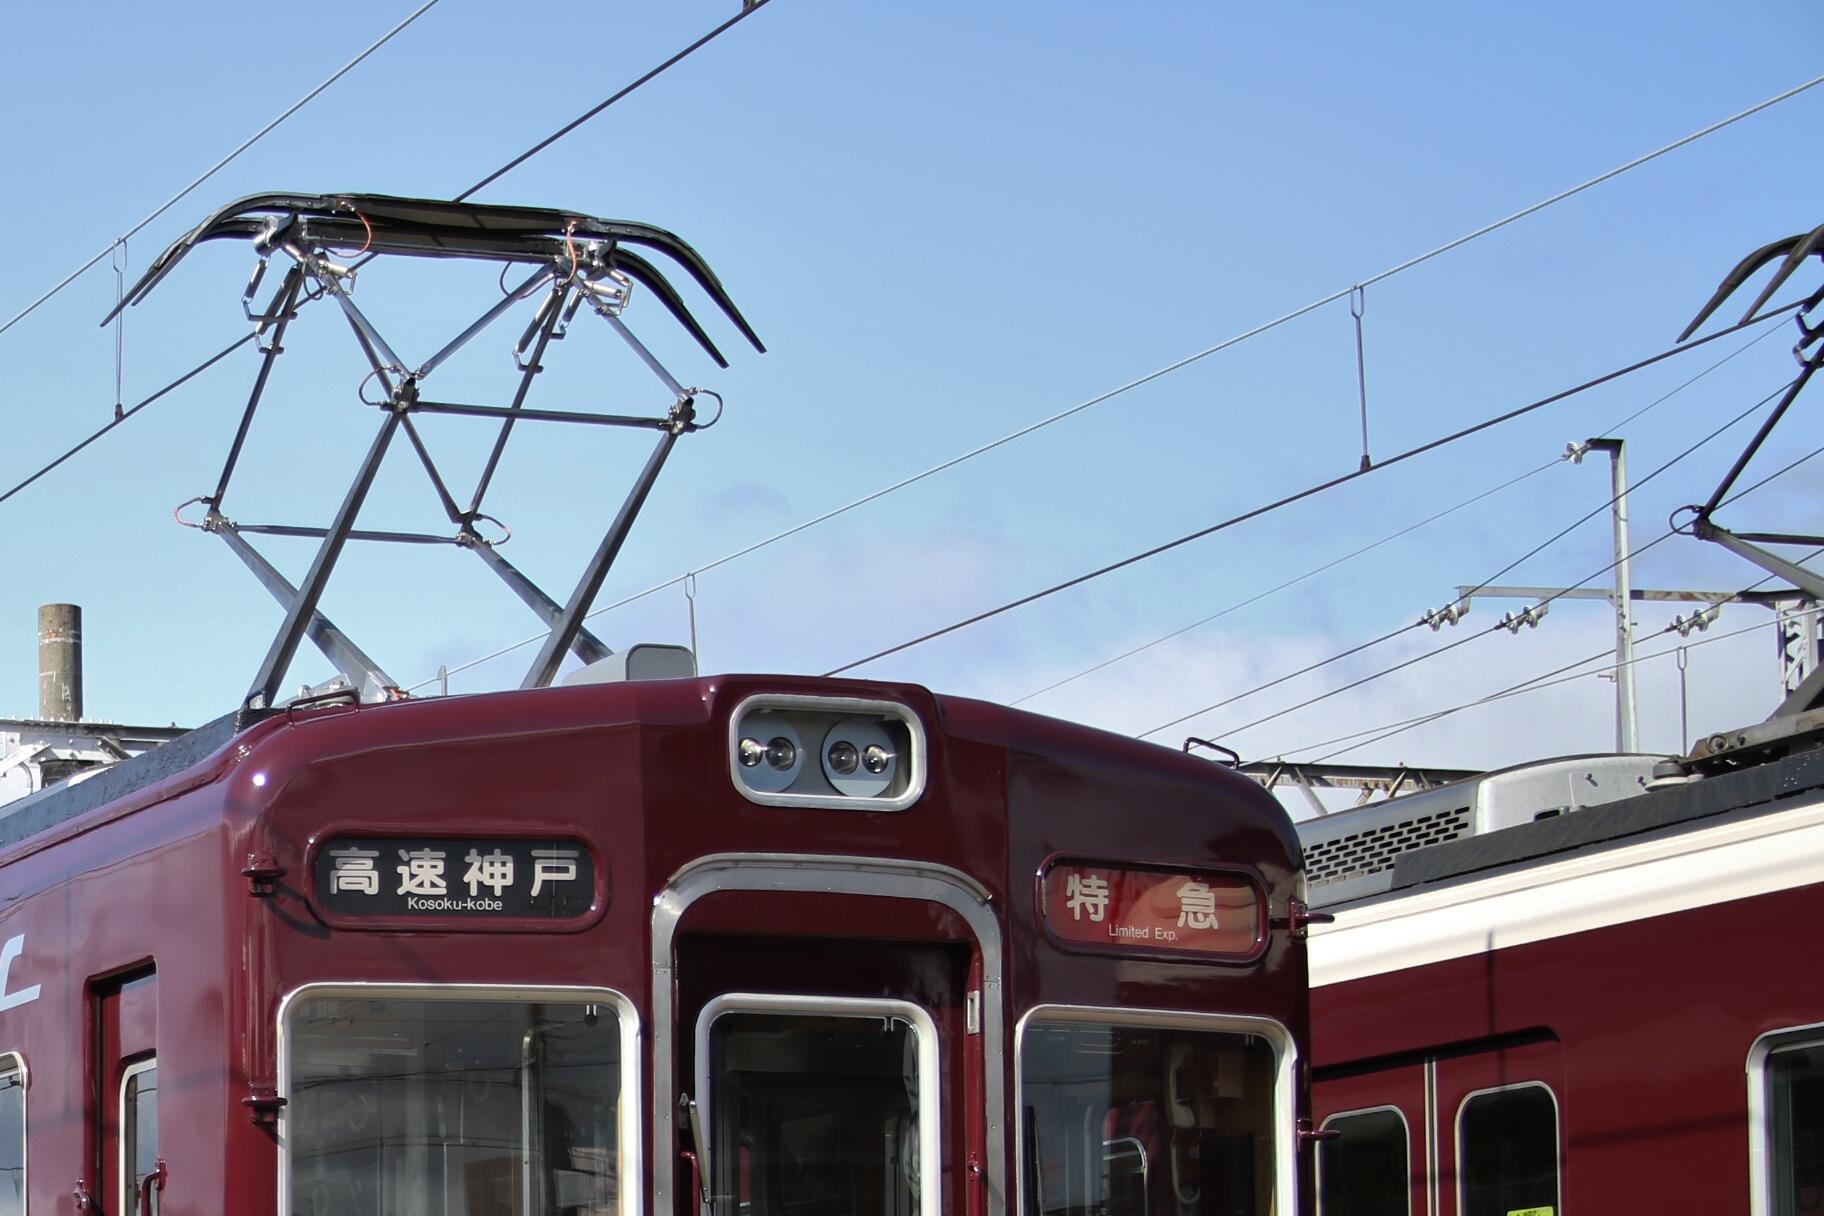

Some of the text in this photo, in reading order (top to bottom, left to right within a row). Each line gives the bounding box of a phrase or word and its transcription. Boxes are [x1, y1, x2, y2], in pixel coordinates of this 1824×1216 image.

[328, 847, 581, 897] 高速神戸
[407, 896, 503, 911] Kosoku-kobe
[1108, 923, 1179, 941] Limited Exp.
